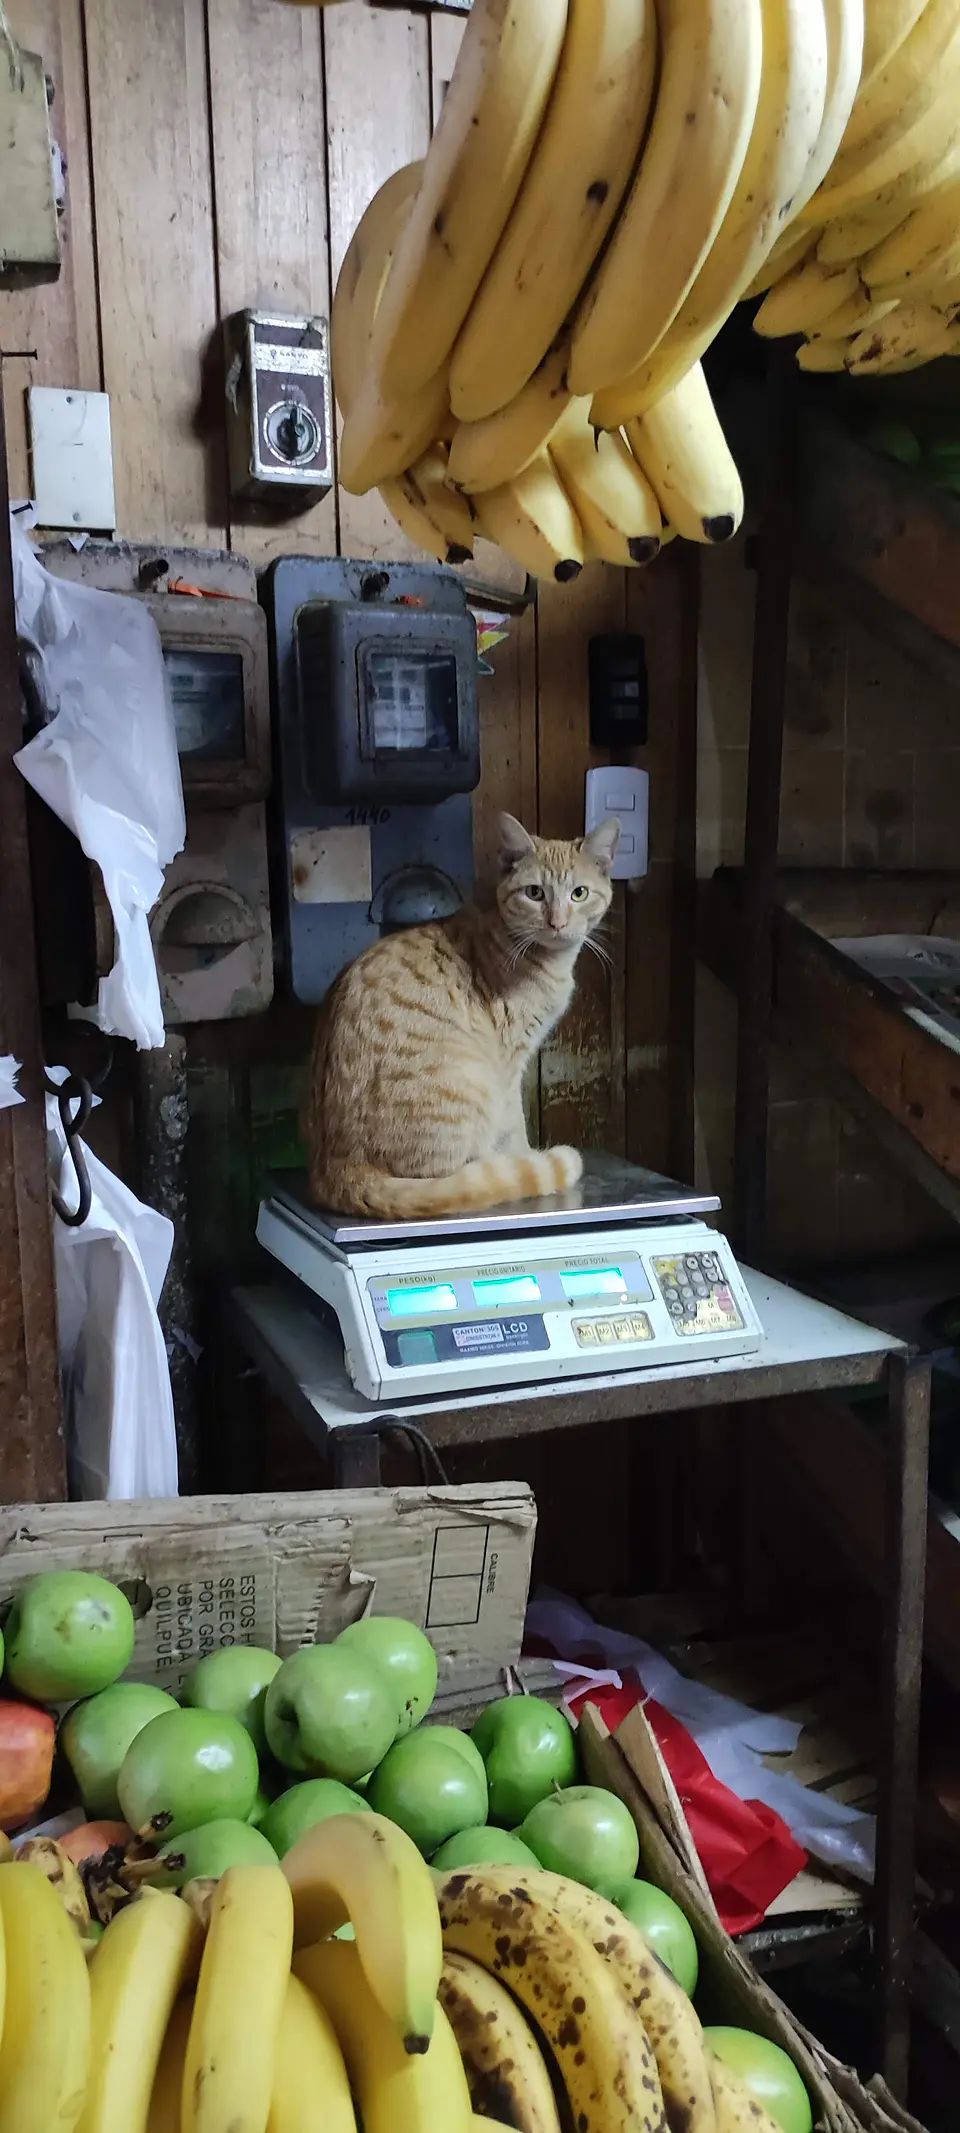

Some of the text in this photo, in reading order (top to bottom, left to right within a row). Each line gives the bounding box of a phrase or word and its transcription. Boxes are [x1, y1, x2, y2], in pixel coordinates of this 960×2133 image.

[477, 1267, 499, 1276] PRECIO
[564, 1256, 610, 1268] PRECIO TOTAL
[455, 1326, 484, 1336] CANTON
[502, 1321, 528, 1334] LCD
[486, 1552, 499, 1594] CALIBRE
[198, 1579, 214, 1615] POR
[240, 1575, 256, 1629] ESTOS
[177, 1582, 193, 1663] UBICADA
